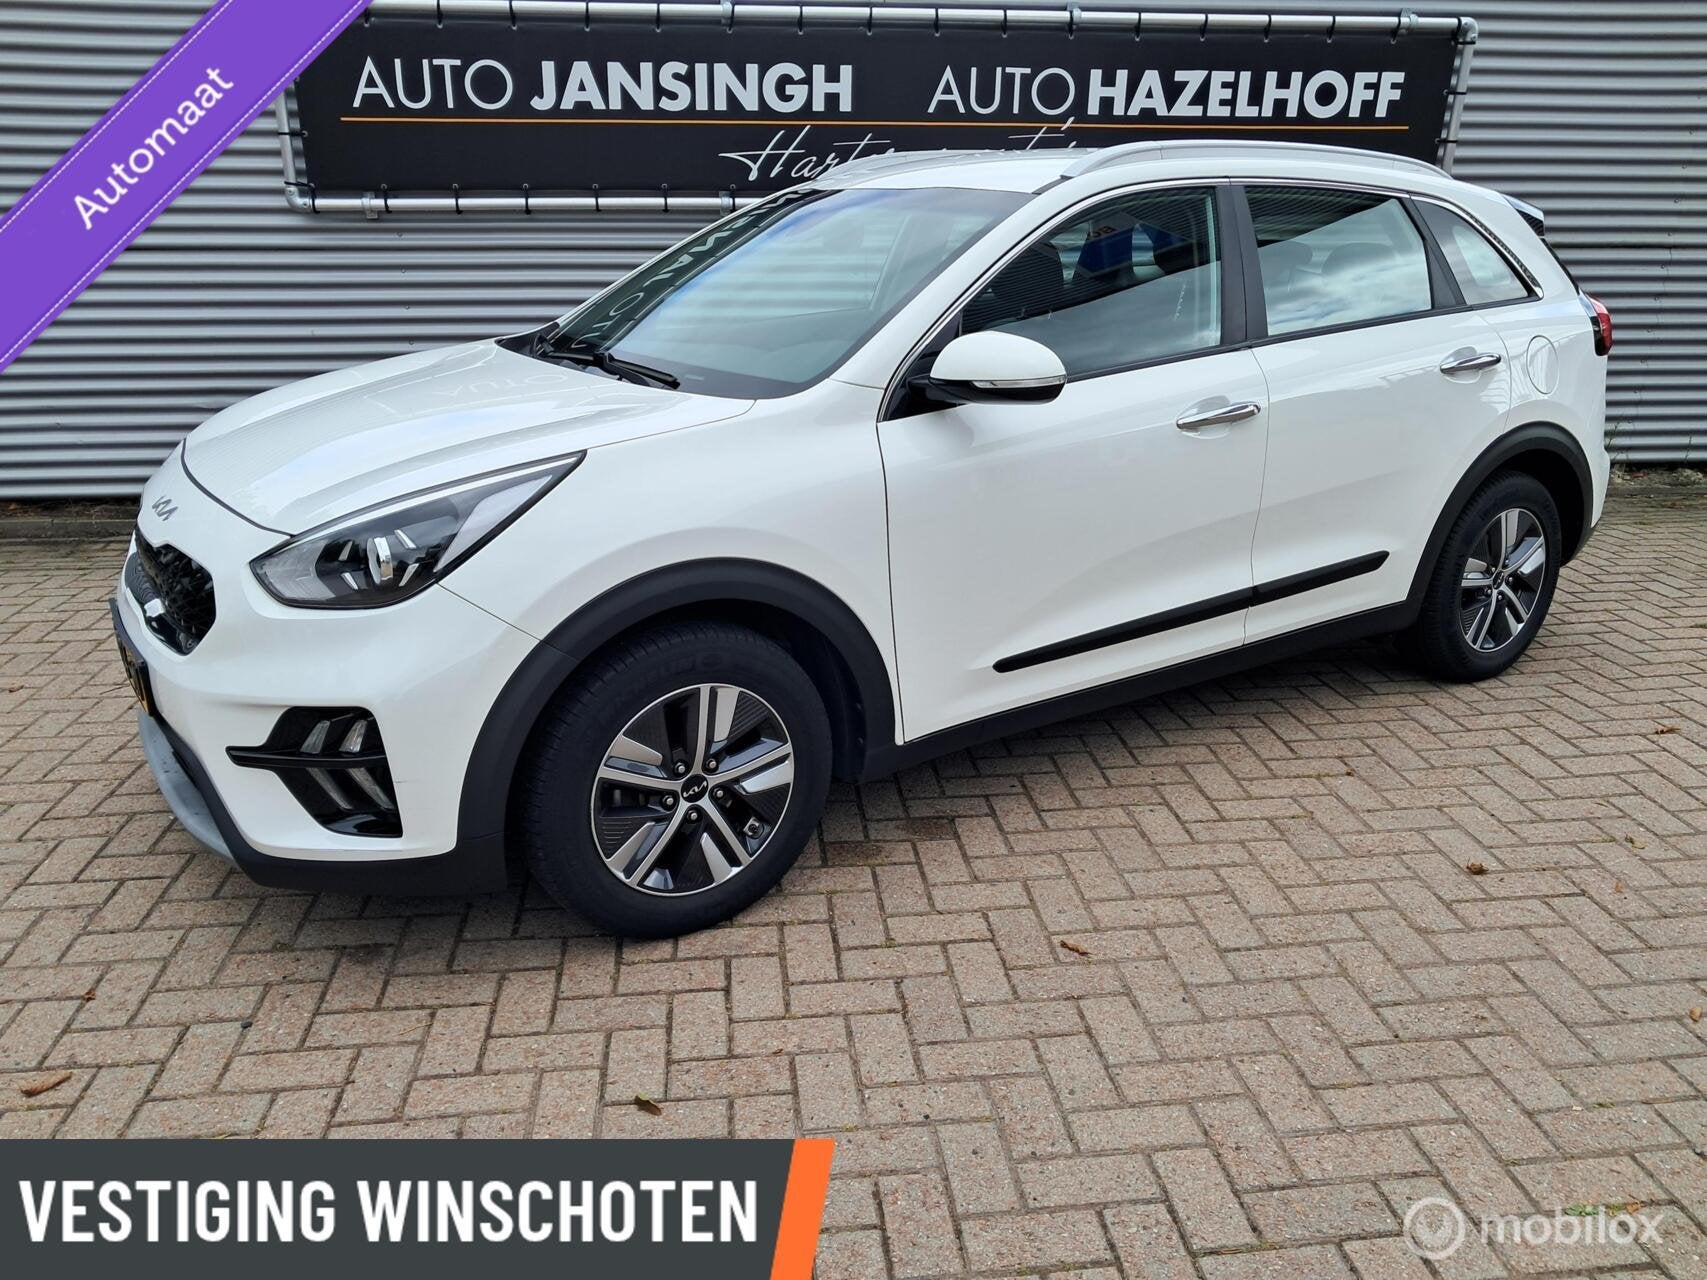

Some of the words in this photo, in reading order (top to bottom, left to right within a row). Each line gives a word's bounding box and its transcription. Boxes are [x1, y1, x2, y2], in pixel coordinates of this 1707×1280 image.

[353, 56, 513, 110] AUTO
[530, 61, 853, 113] JANSINGH
[928, 66, 1075, 115] AUTO
[1087, 69, 1406, 118] HAZELHOFF
